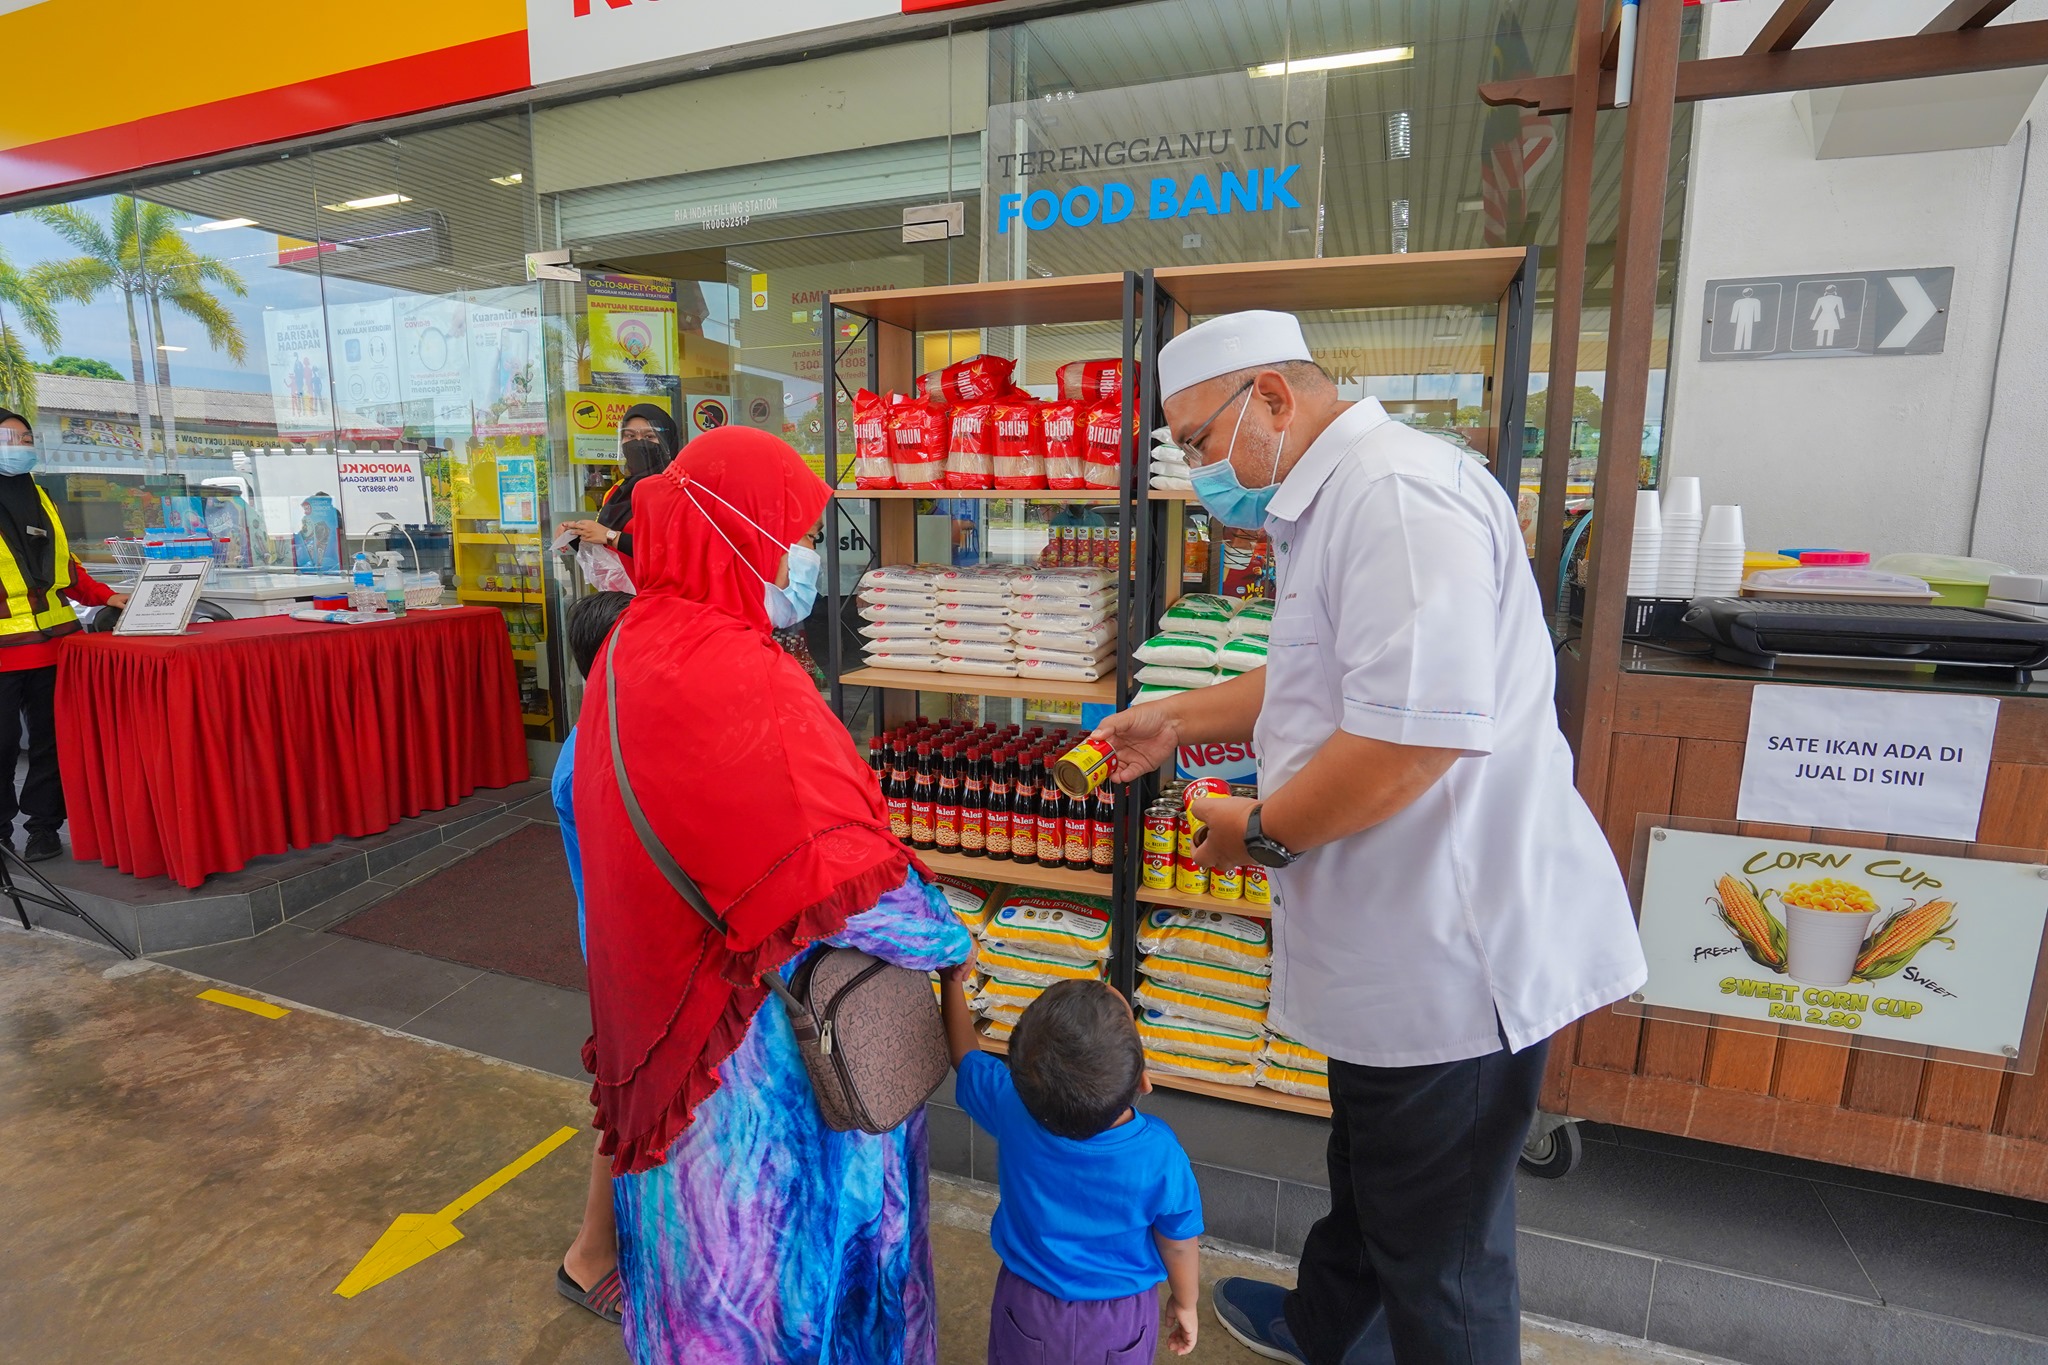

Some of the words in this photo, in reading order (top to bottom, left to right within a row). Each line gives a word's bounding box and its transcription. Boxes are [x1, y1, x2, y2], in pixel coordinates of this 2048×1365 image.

[997, 128, 1231, 178] TERENGGANU
[1244, 120, 1309, 152] INC
[997, 182, 1135, 234] FOOD
[1149, 164, 1301, 221] BANK
[674, 210, 688, 222] RIA
[689, 206, 712, 219] INDAH
[714, 202, 742, 216] FILLING
[745, 198, 778, 212] STATION
[588, 280, 675, 294] GO-TO-SAFETY-POINT
[472, 309, 518, 323] Kuarantin
[520, 307, 538, 318] diri
[590, 302, 628, 310] BANTUAN
[629, 304, 675, 313] KECEMASAN
[276, 328, 320, 342] BARISAN
[278, 340, 320, 352] HADAPAN
[793, 360, 820, 371] 1300
[839, 356, 866, 368] 1808
[1324, 366, 1358, 386] NK
[411, 385, 462, 394] mencegahnya
[958, 370, 975, 400] BIHUN
[854, 423, 882, 439] BIHUN
[952, 417, 982, 434] BIHUN
[999, 420, 1029, 436] BIHUN
[1044, 420, 1075, 436] BIHUN
[895, 428, 921, 444] BIHUN
[1088, 426, 1122, 444] BIHUN
[813, 529, 864, 550] Psh
[1246, 582, 1265, 594] Mat
[1178, 742, 1256, 768] Nest
[1767, 736, 1819, 754] SATE
[1825, 739, 1878, 757] IKAN
[1883, 743, 1932, 761] ADA
[1939, 746, 1964, 763] DI
[1795, 764, 1847, 782] JUAL
[1852, 767, 1875, 784] DI
[1880, 769, 1925, 787] SINI
[888, 800, 907, 808] Jalen
[912, 802, 930, 812] Jalen
[936, 806, 956, 816] Jalen
[962, 810, 983, 818] Jalen
[988, 813, 1009, 822] Jalen
[1013, 816, 1034, 824] Jalen
[1037, 817, 1055, 828] Jalen
[1065, 820, 1085, 830] Jalen
[1742, 851, 1852, 875] CORN
[1864, 859, 1942, 890] CUP
[1018, 898, 1052, 906] PILIHAN
[1052, 902, 1093, 916] ISTIMEWA
[1693, 946, 1742, 964] FRESH
[1902, 966, 1958, 999] SWEET
[1718, 976, 1800, 1002] SWEET
[1803, 987, 1869, 1013] CORN
[1872, 997, 1923, 1020] CUP
[1768, 1002, 1802, 1021] RM
[1804, 1008, 1862, 1030] 2.80
